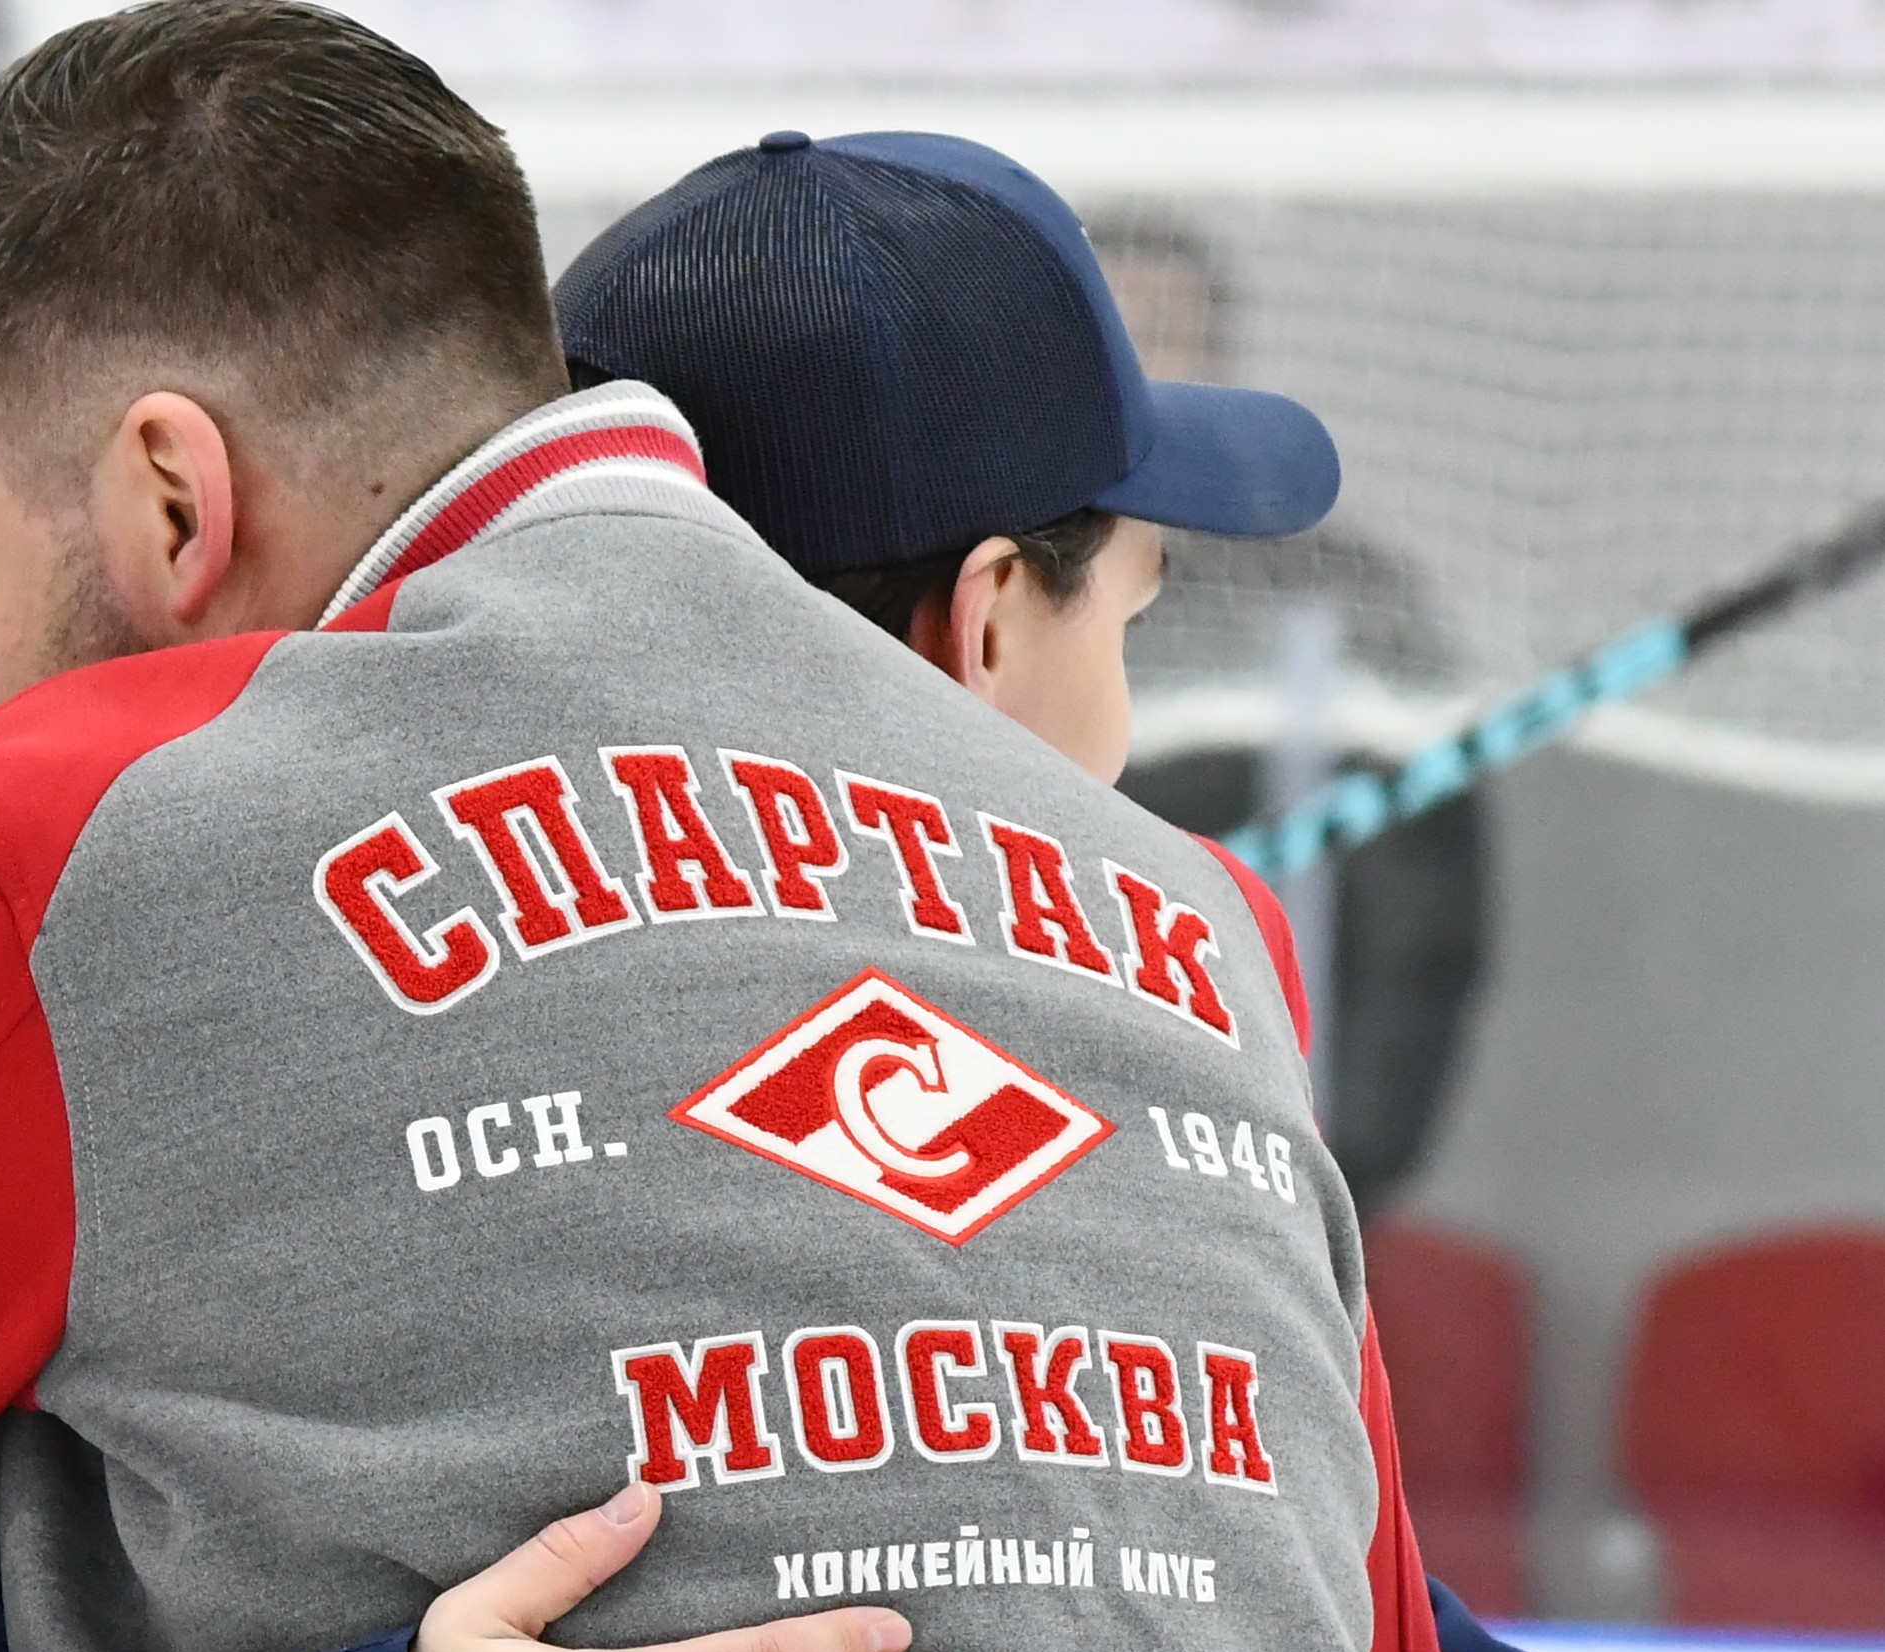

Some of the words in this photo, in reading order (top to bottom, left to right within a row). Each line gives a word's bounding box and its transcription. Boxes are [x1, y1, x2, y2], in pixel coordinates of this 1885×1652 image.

[313, 744, 1241, 1049] СПАРТАК
[405, 1090, 628, 1191] ОСН.
[1148, 1106, 1295, 1202] 1946
[611, 1319, 1278, 1495] МОСКВА
[774, 1525, 1095, 1598] ХОККЕЙНЫЙ
[1120, 1556, 1215, 1601] КЛУБ
